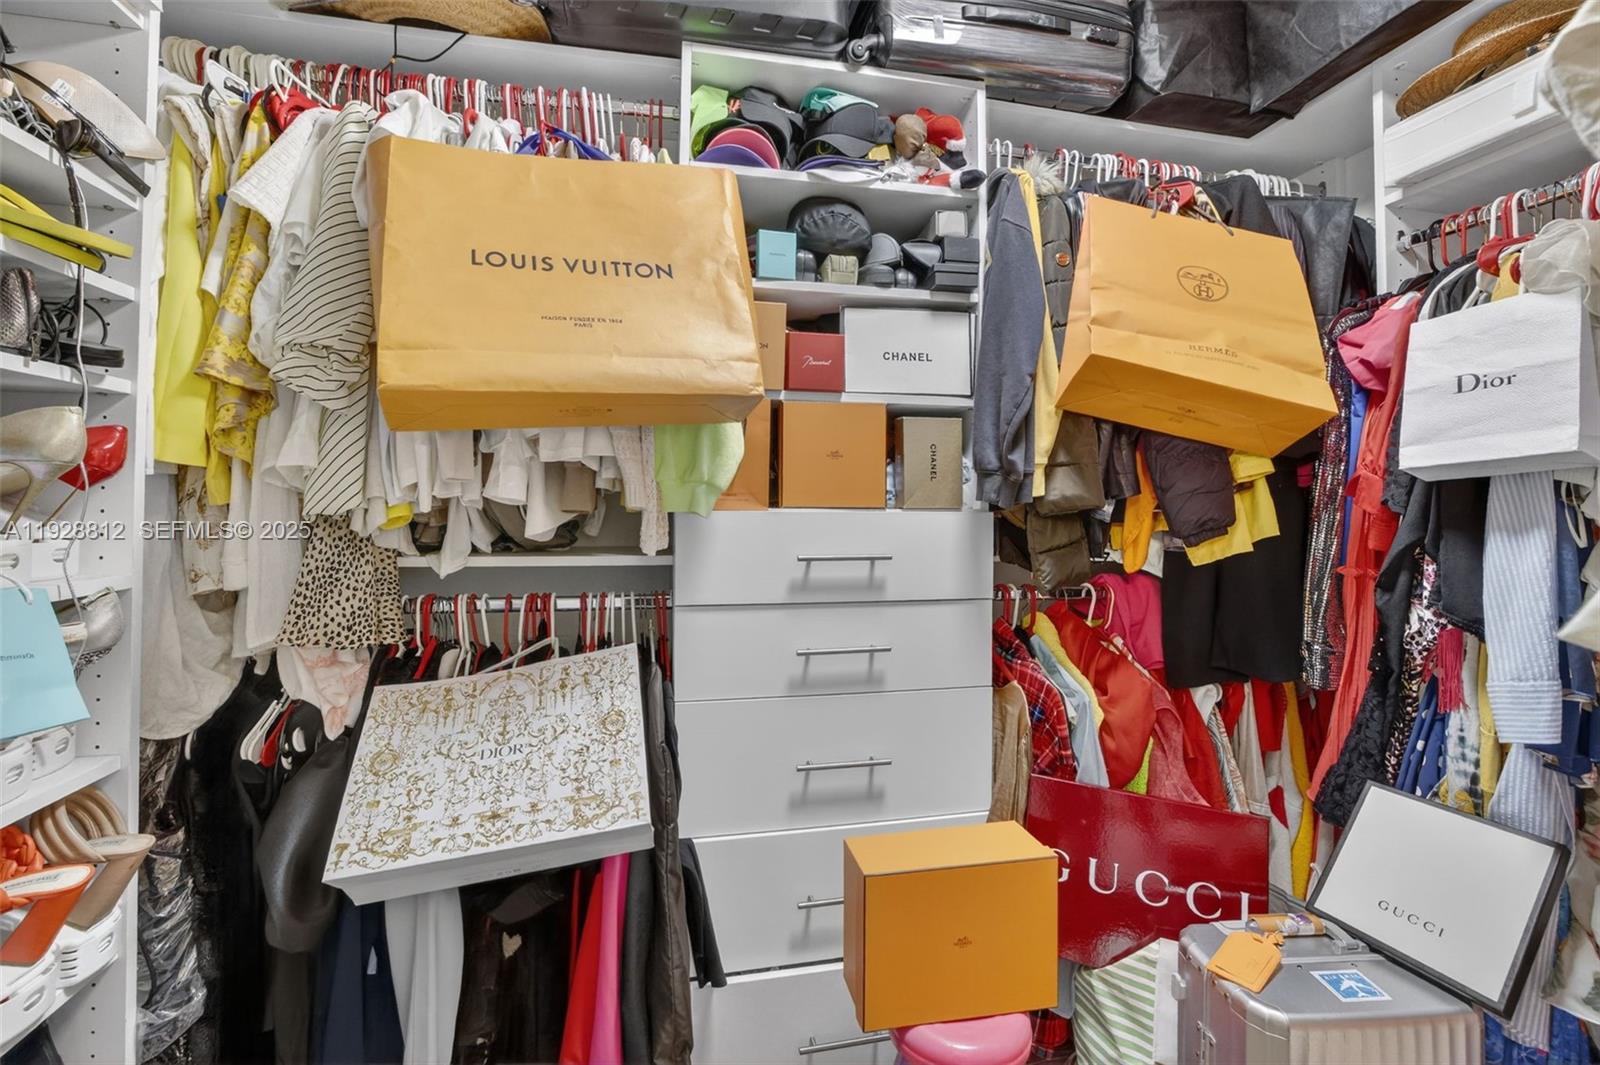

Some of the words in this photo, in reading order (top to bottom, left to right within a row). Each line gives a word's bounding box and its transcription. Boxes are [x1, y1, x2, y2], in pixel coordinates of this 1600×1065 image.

[471, 249, 554, 272] LOUIS
[563, 257, 674, 279] VUITTON
[882, 351, 933, 363] CHANEL
[1453, 373, 1517, 394] Dior
[929, 443, 937, 482] CHANEL
[480, 743, 524, 760] DIOR
[1378, 900, 1444, 937] GUCCI
